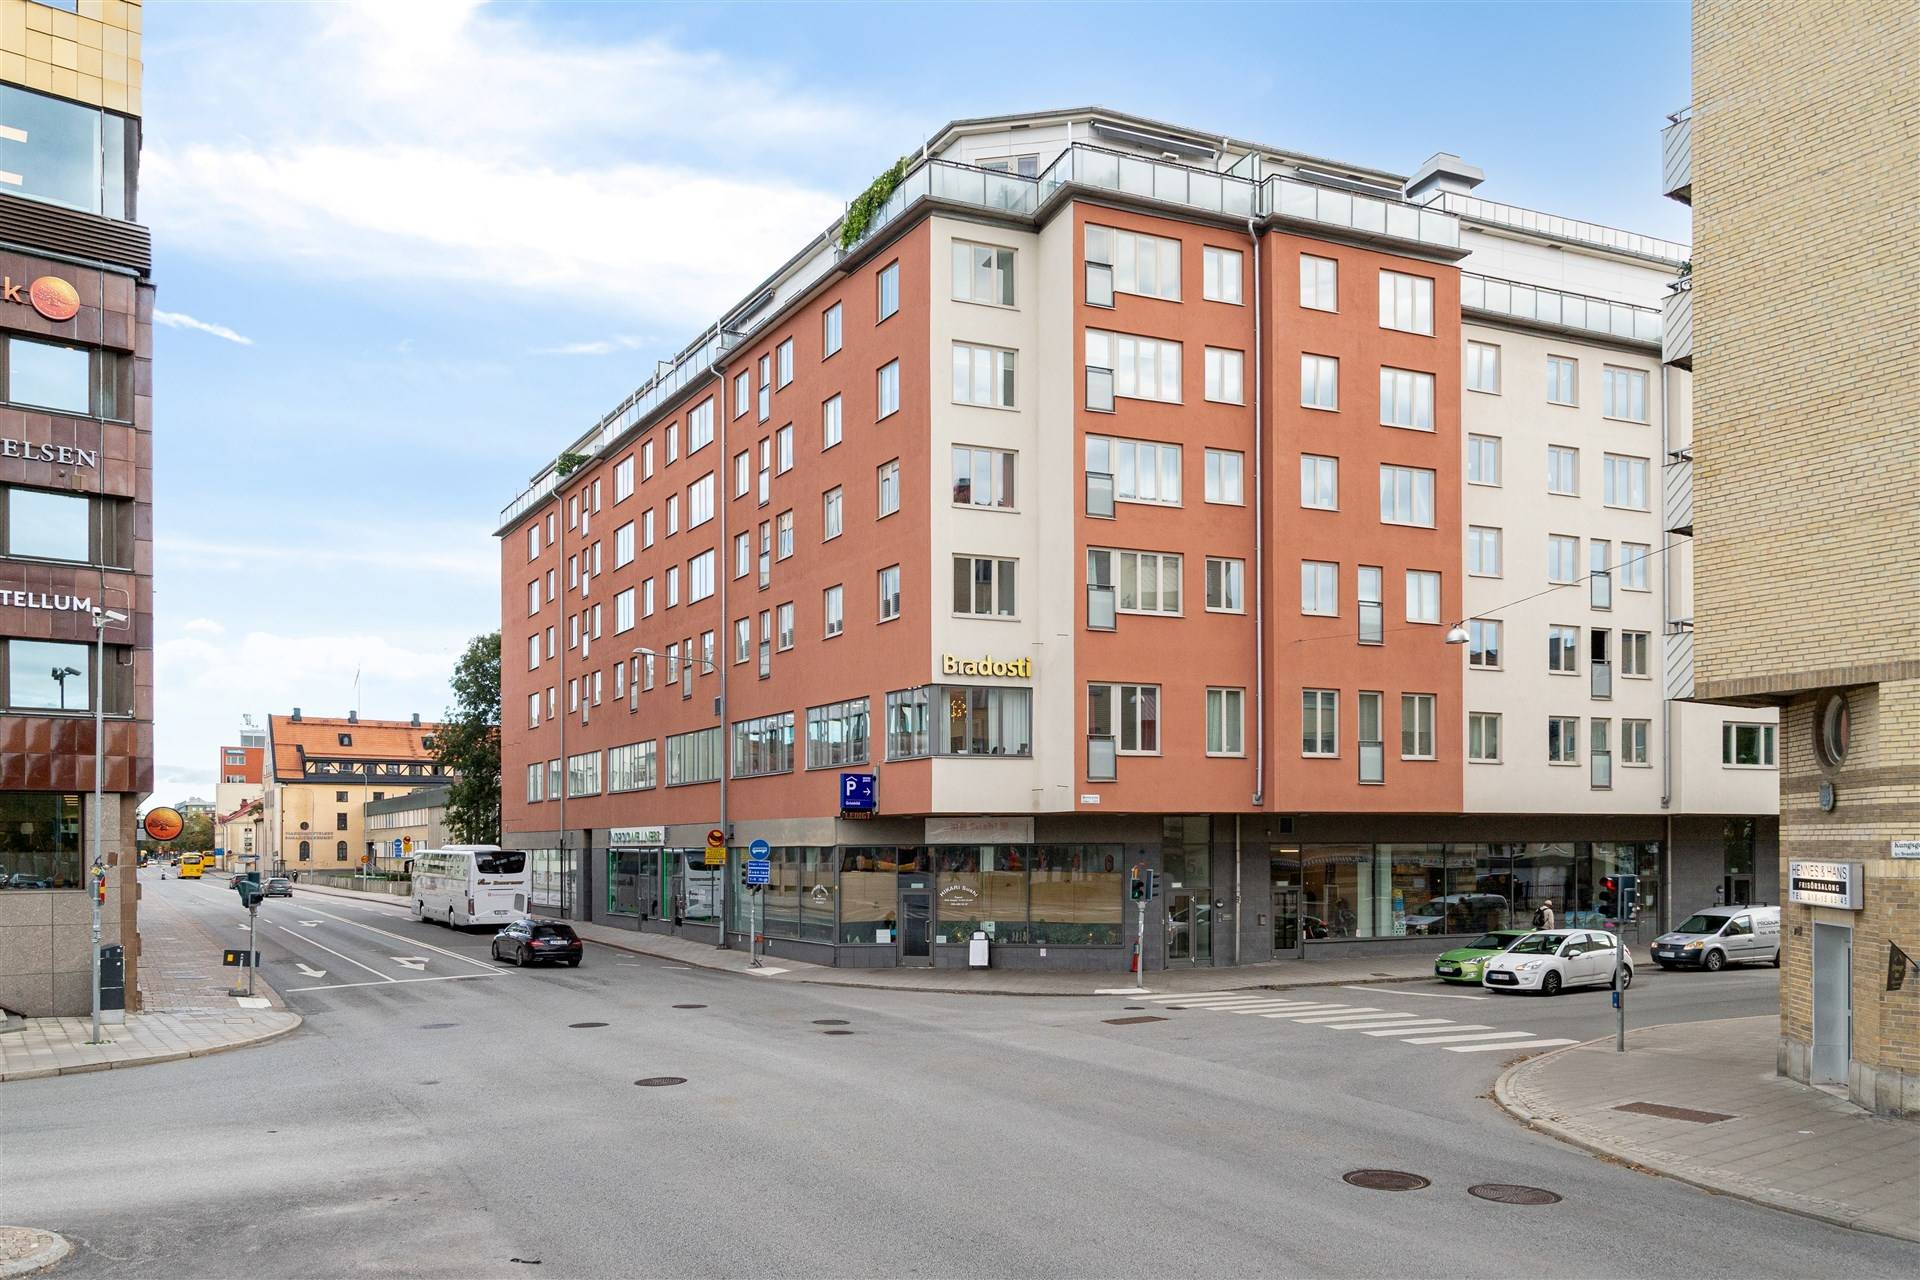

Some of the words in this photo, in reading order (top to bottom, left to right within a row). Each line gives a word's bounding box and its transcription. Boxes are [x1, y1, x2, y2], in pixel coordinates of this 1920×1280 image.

[1, 438, 97, 468] ELSEN
[0, 589, 91, 612] TELLUM
[942, 654, 1032, 677] Bradosti
[846, 780, 857, 796] P
[1792, 863, 1820, 879] HENNES
[1827, 865, 1848, 880] HANS
[1798, 881, 1841, 893] FRISÖRSALONG
